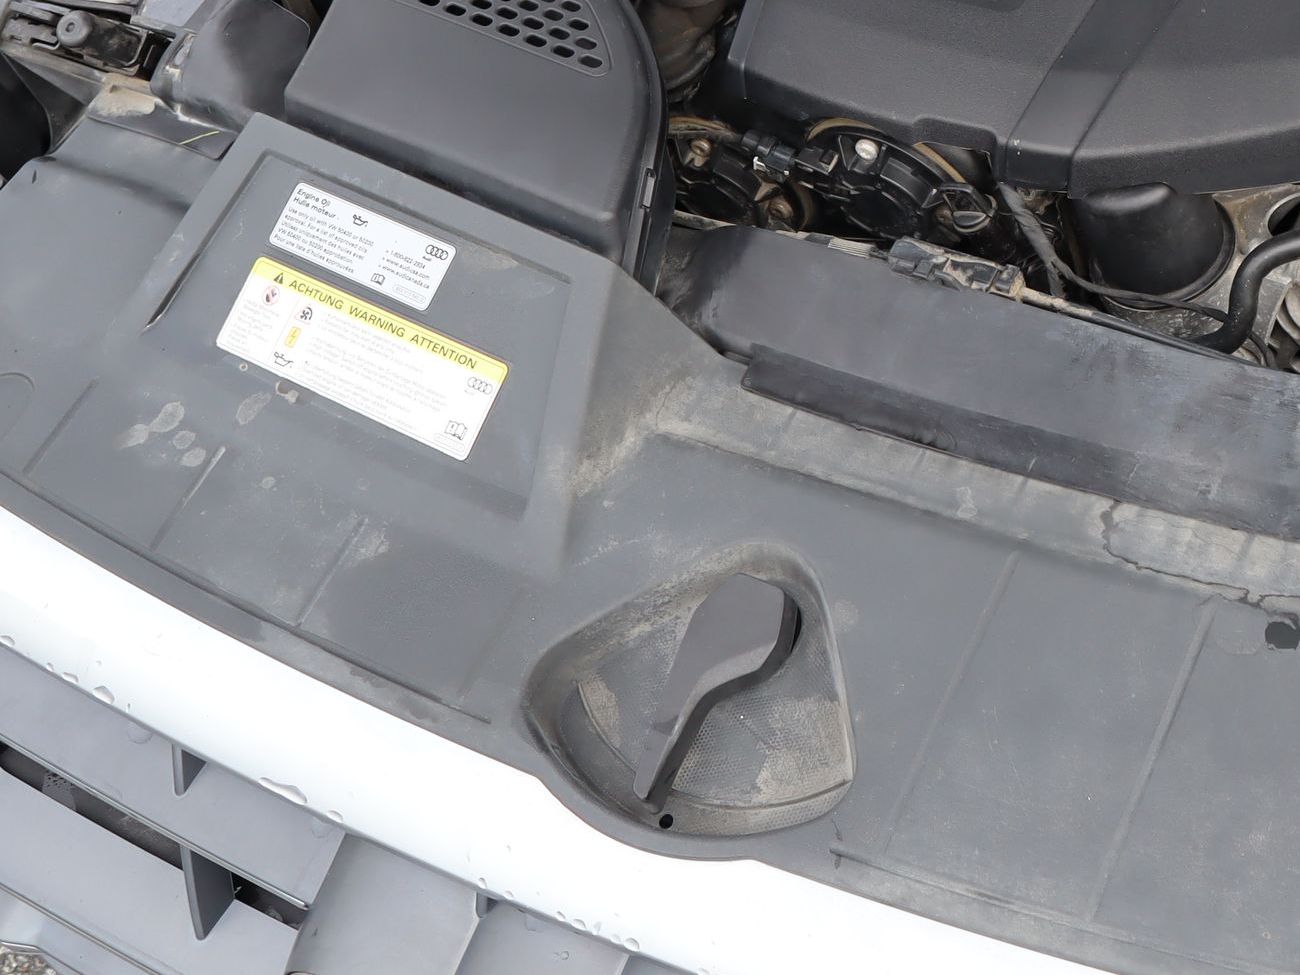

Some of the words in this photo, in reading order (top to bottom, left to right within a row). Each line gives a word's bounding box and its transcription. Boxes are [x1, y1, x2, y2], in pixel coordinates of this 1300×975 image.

[296, 187, 320, 203] Engine
[310, 204, 336, 219] moteur
[288, 280, 343, 310] ACHTUNG
[349, 305, 406, 337] WARNING
[410, 333, 477, 369] ATTENTION
